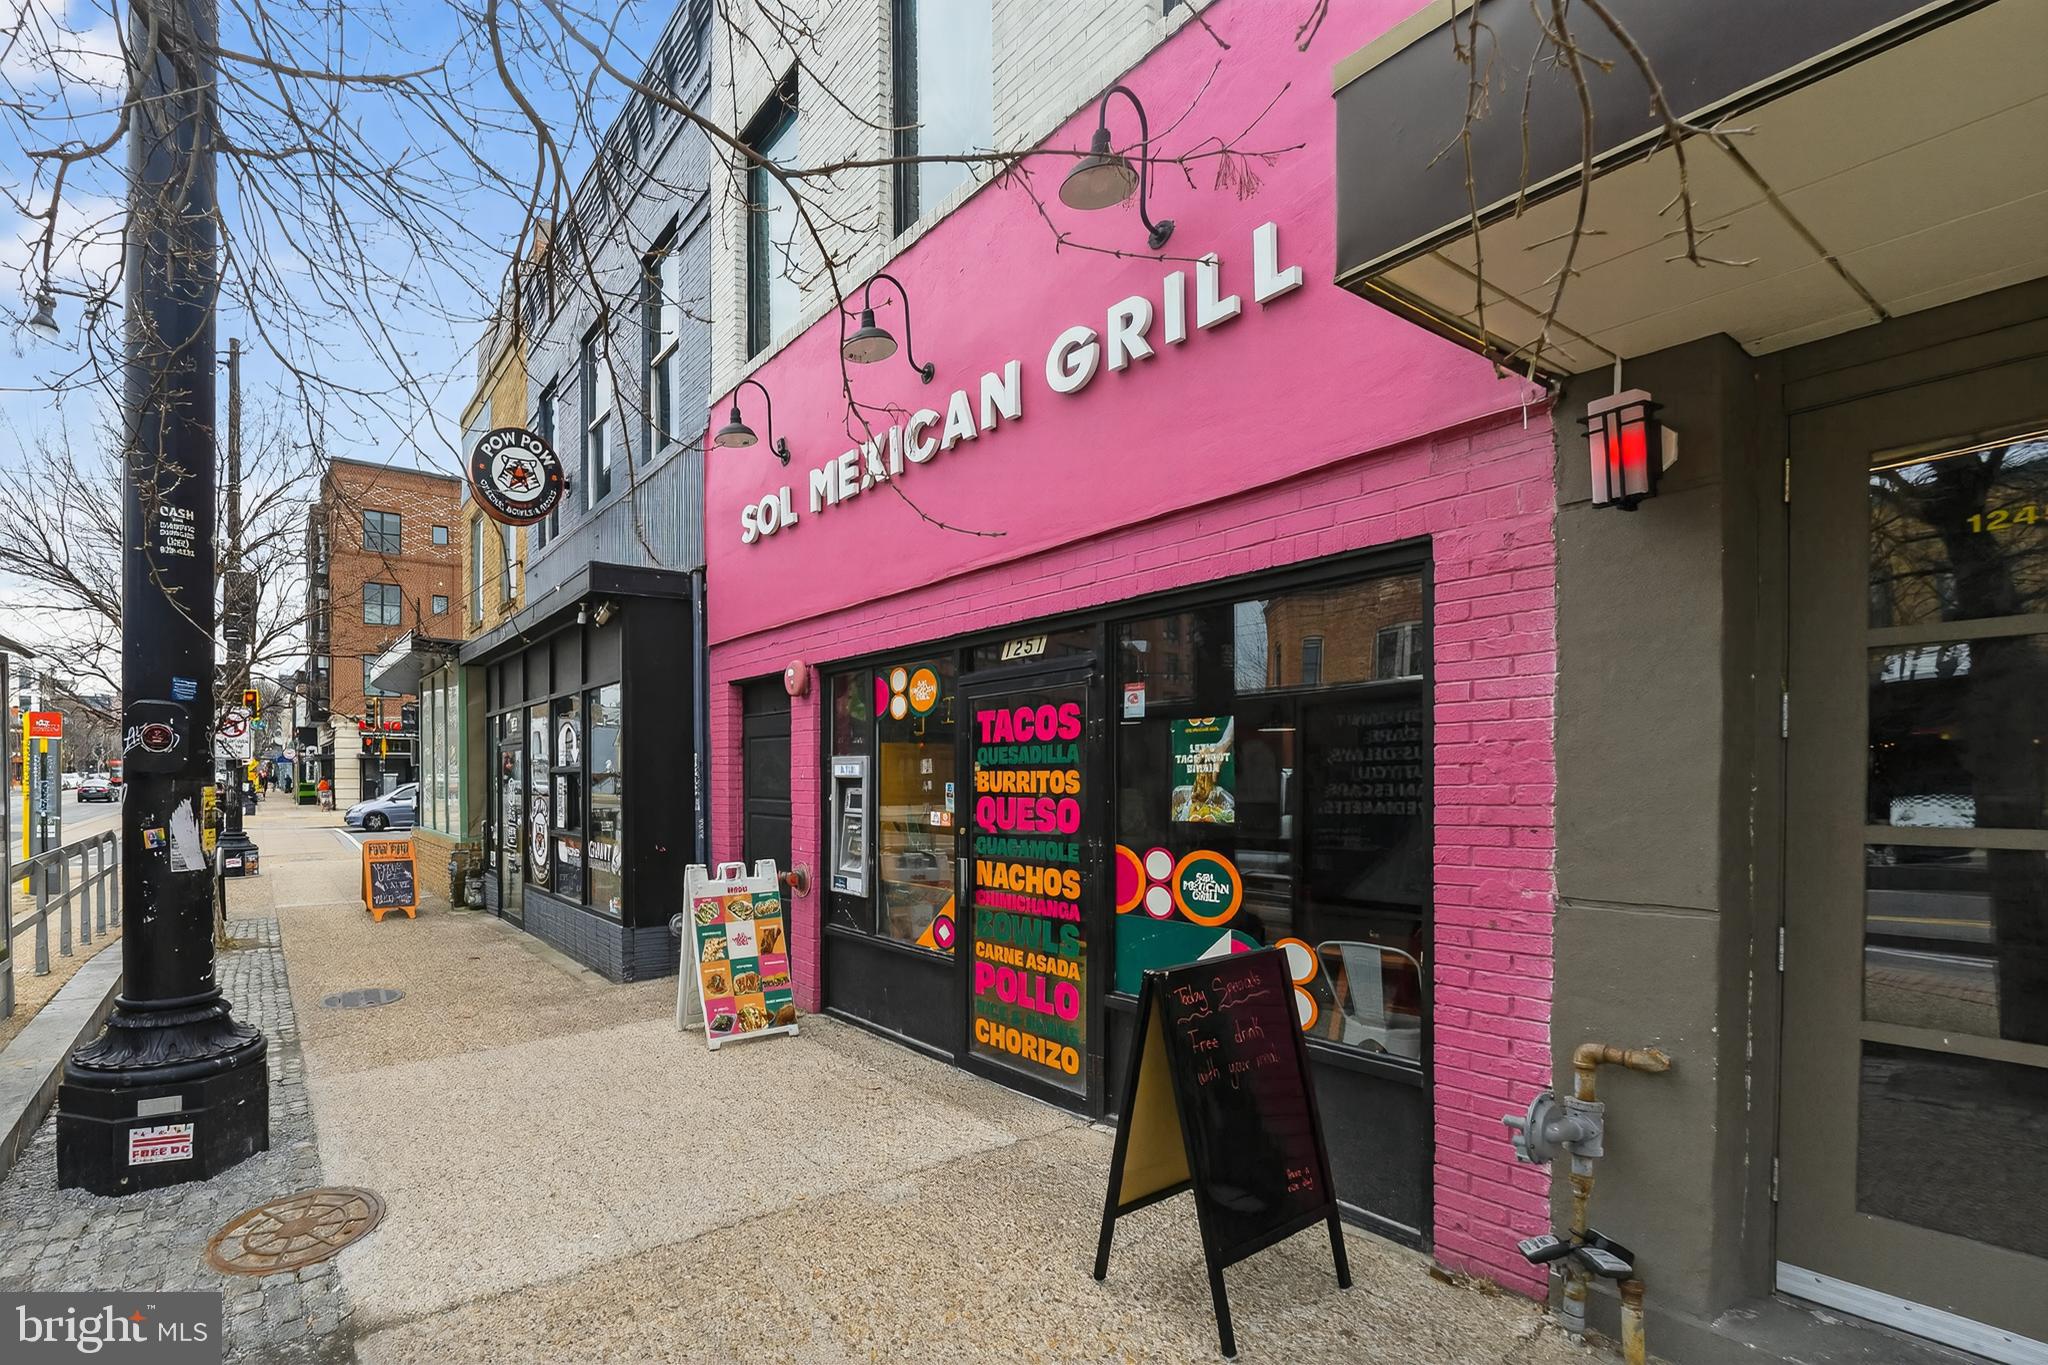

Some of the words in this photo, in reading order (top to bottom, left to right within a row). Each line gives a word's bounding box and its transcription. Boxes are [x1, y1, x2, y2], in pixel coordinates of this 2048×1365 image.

[741, 486, 798, 545] SOL
[809, 360, 1021, 513] MEXICAN
[1045, 221, 1303, 393] GRILL
[481, 432, 516, 457] POW
[521, 434, 555, 466] POW
[160, 505, 194, 520] CASH
[1967, 503, 2048, 533] 124
[1006, 637, 1042, 657] 1251
[976, 703, 1081, 744] TACOS
[977, 744, 1080, 767] QUESADILLA
[976, 770, 1081, 794] BURRITOS
[975, 796, 1081, 834] QUESO
[975, 836, 1080, 863] GUACAMOLE
[976, 860, 1081, 899] NACHOS
[1183, 880, 1229, 895] MEXICAN
[1196, 872, 1214, 882] SOL
[975, 889, 1081, 922] CHIMICHANGA
[1192, 890, 1220, 903] GRILL
[976, 908, 1080, 957] BOWLS
[975, 941, 1024, 969] CARNE
[1026, 953, 1081, 981] ASADA
[975, 960, 1080, 1021] POLLO
[1173, 984, 1209, 1012] Today
[975, 1018, 1080, 1075] CHORIZO
[1188, 1029, 1219, 1053] Free
[1234, 1016, 1264, 1043] drink
[1198, 1056, 1220, 1086] with
[1229, 1060, 1250, 1090] your
[132, 1146, 168, 1159] FREE
[170, 1145, 190, 1154] DC
